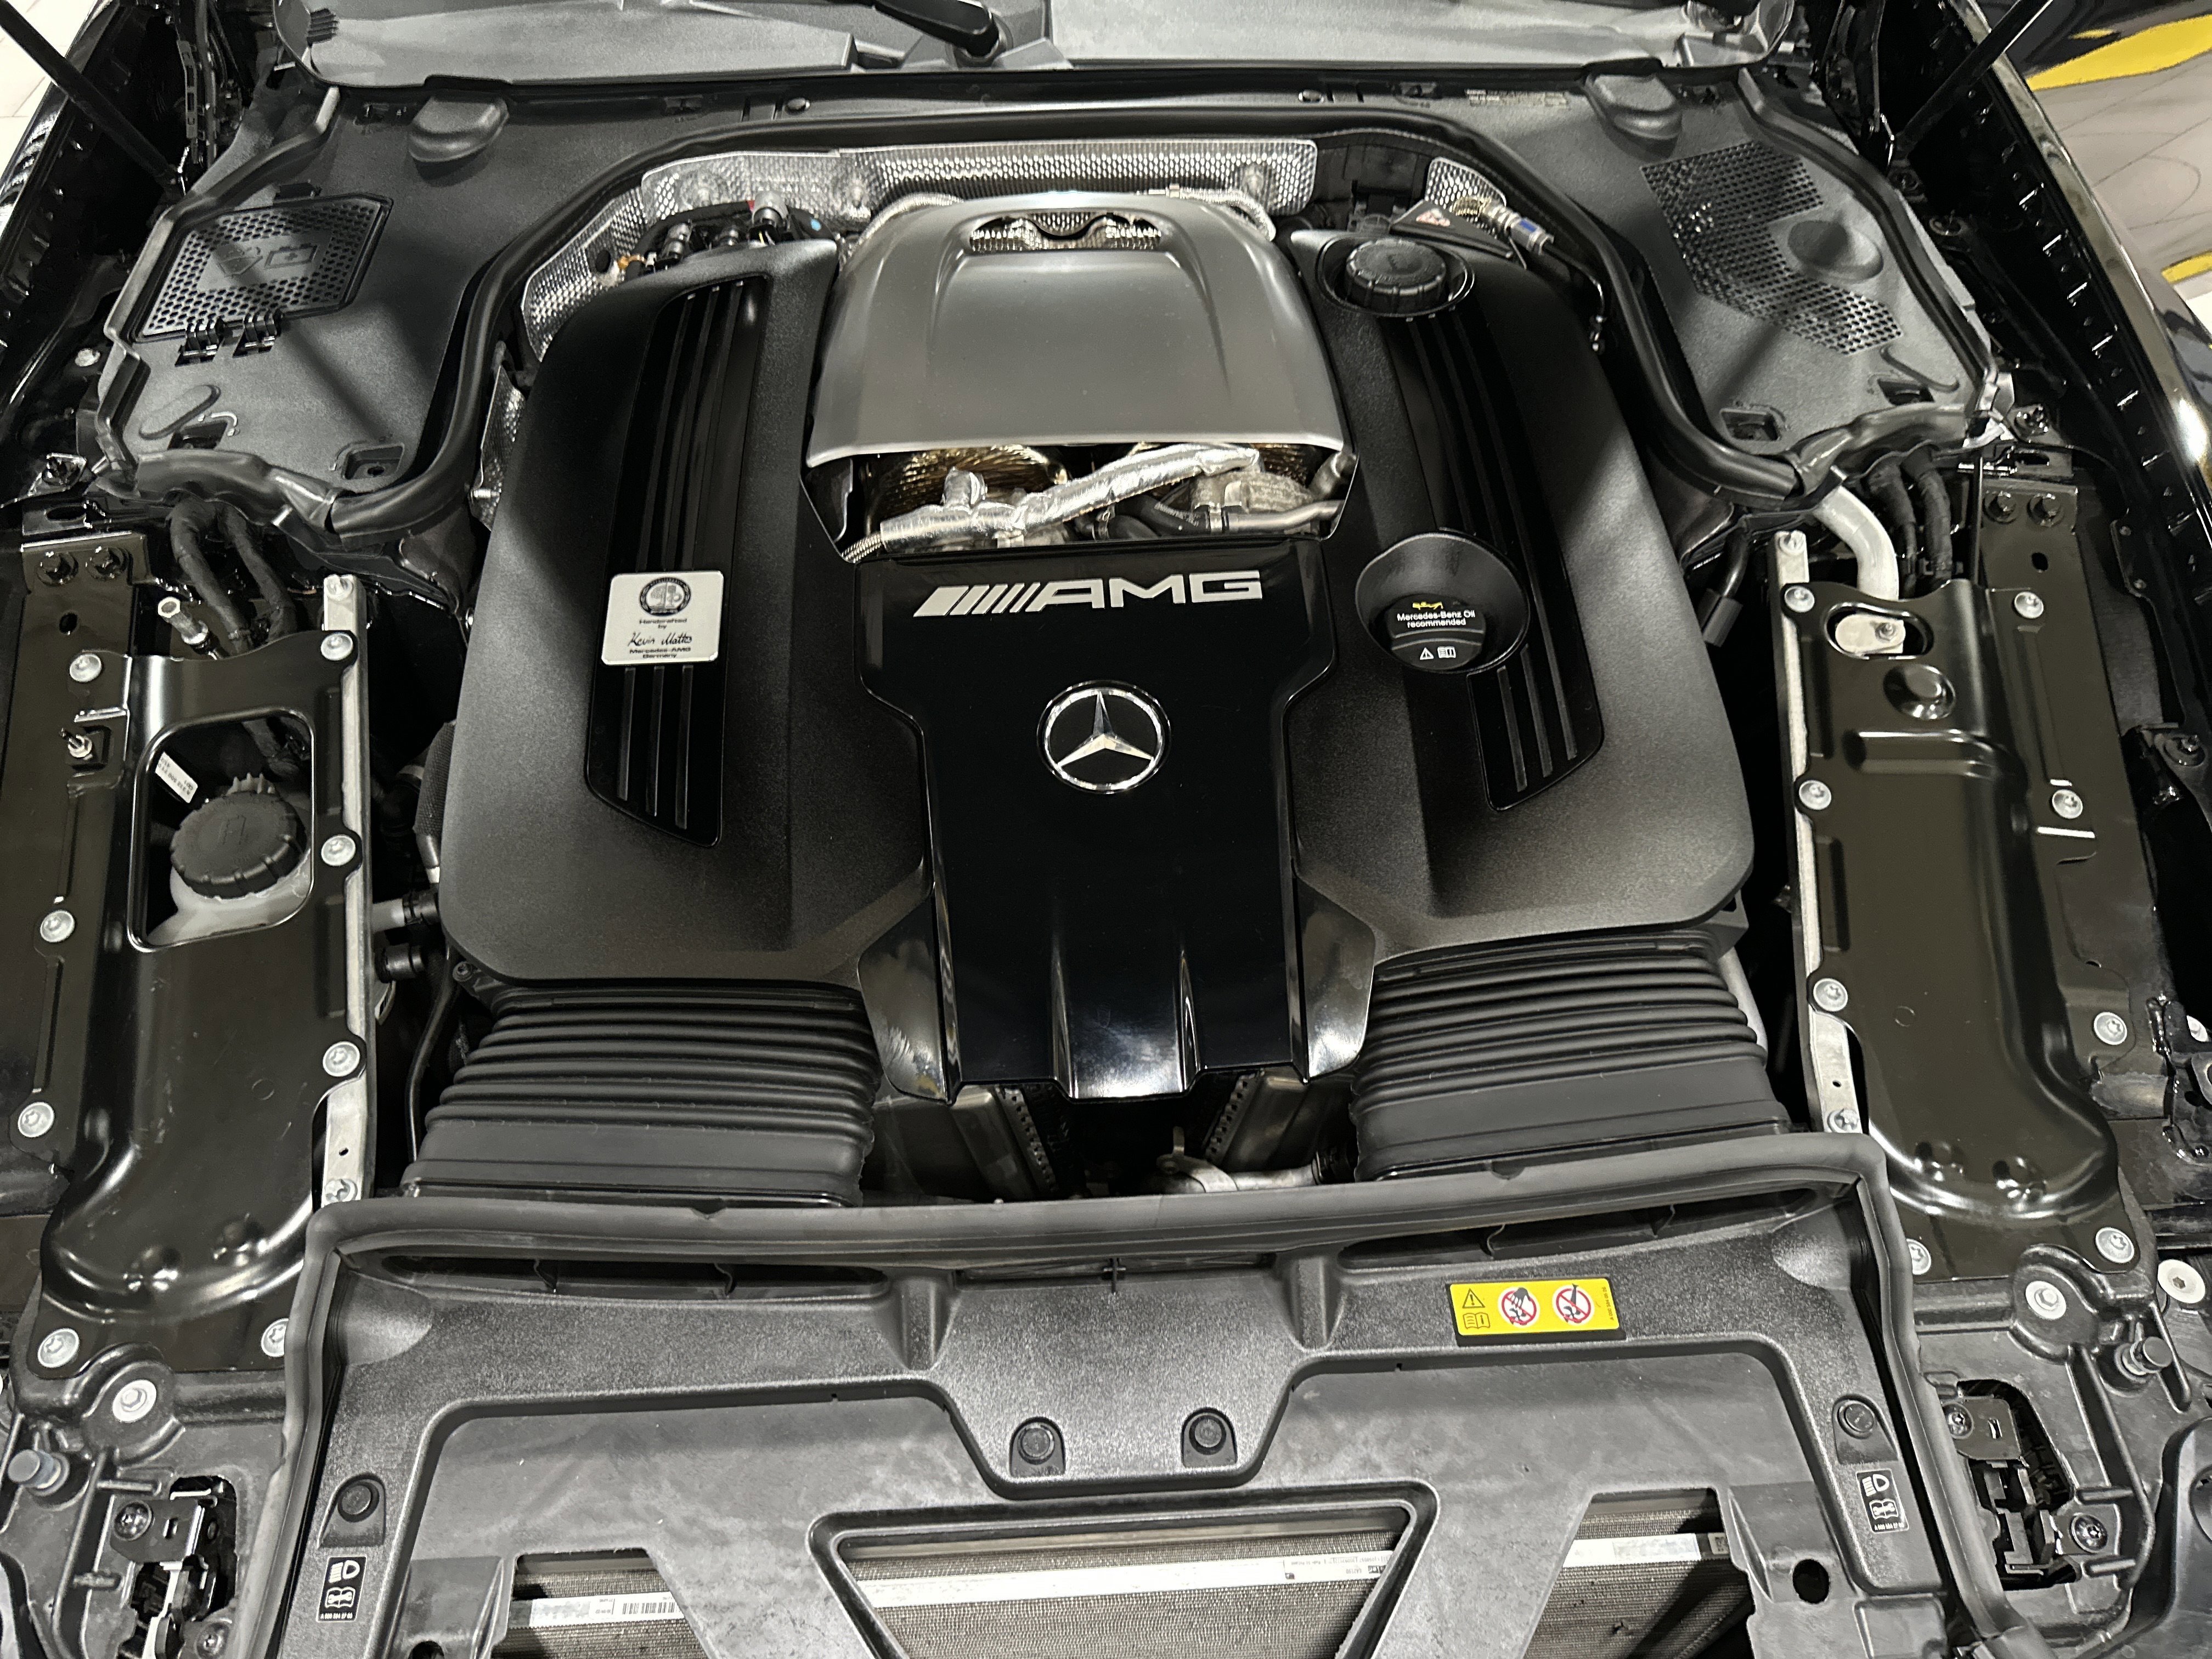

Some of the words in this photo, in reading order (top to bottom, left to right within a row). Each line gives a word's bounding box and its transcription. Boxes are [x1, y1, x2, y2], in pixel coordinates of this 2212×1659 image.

[1025, 570, 1262, 613] AMG
[1397, 610, 1462, 621] Mercedes-Benz
[1463, 610, 1475, 618] Oil
[1407, 618, 1466, 628] recommended
